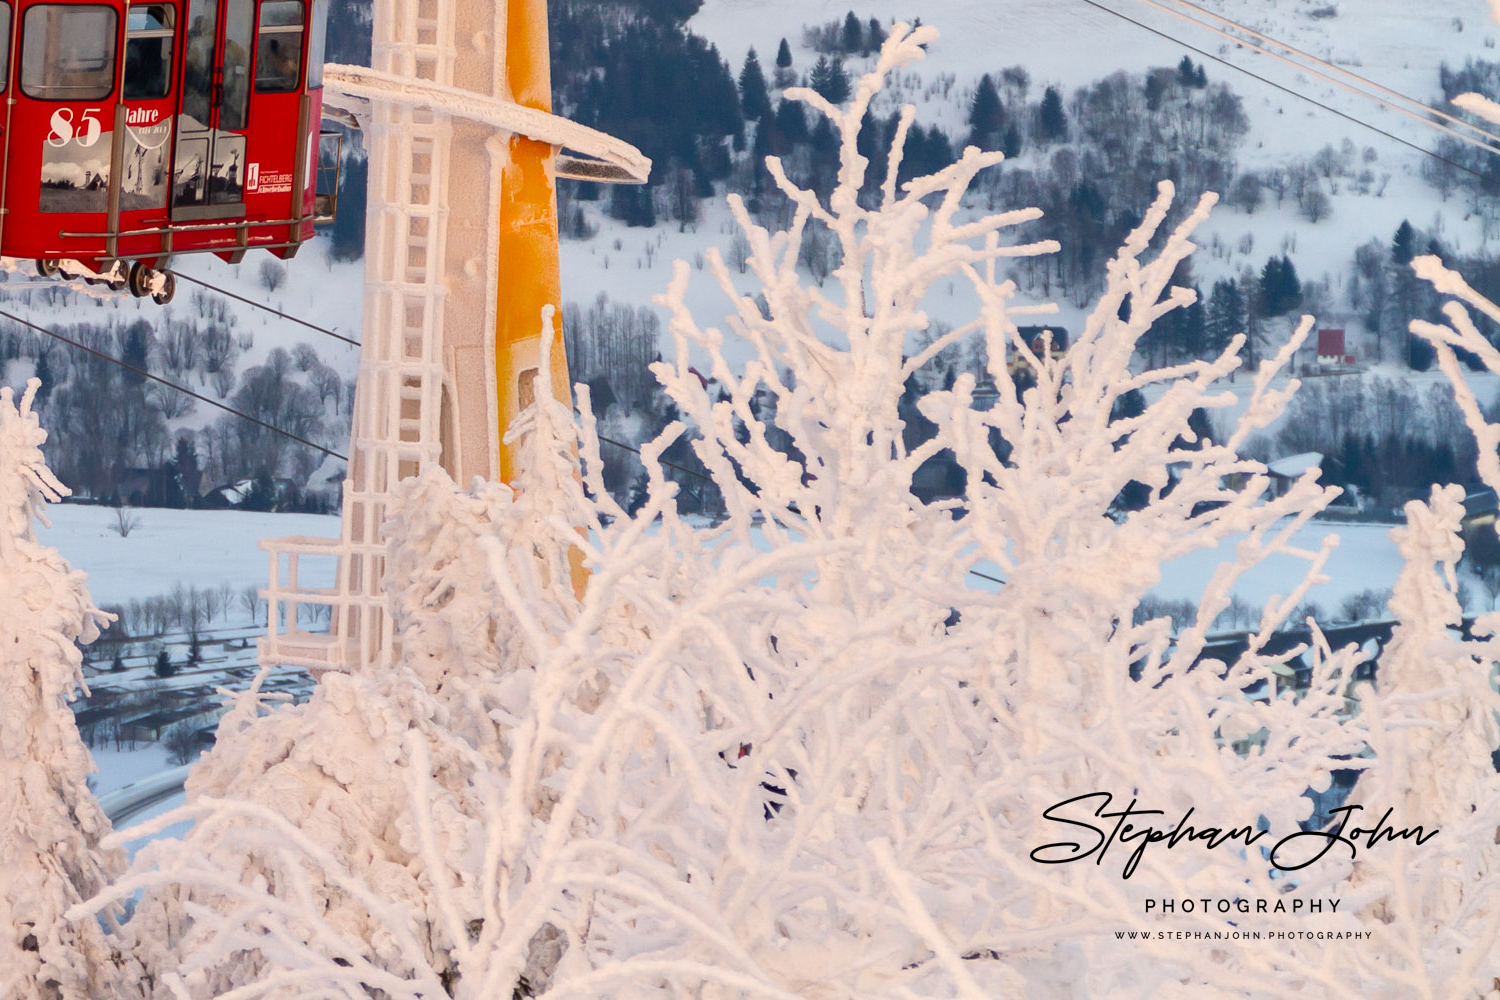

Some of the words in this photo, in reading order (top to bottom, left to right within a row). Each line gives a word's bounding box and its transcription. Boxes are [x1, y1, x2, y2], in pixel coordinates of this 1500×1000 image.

[47, 107, 101, 147] 85
[125, 107, 158, 124] Jahre
[259, 174, 292, 184] FICHTELBERG
